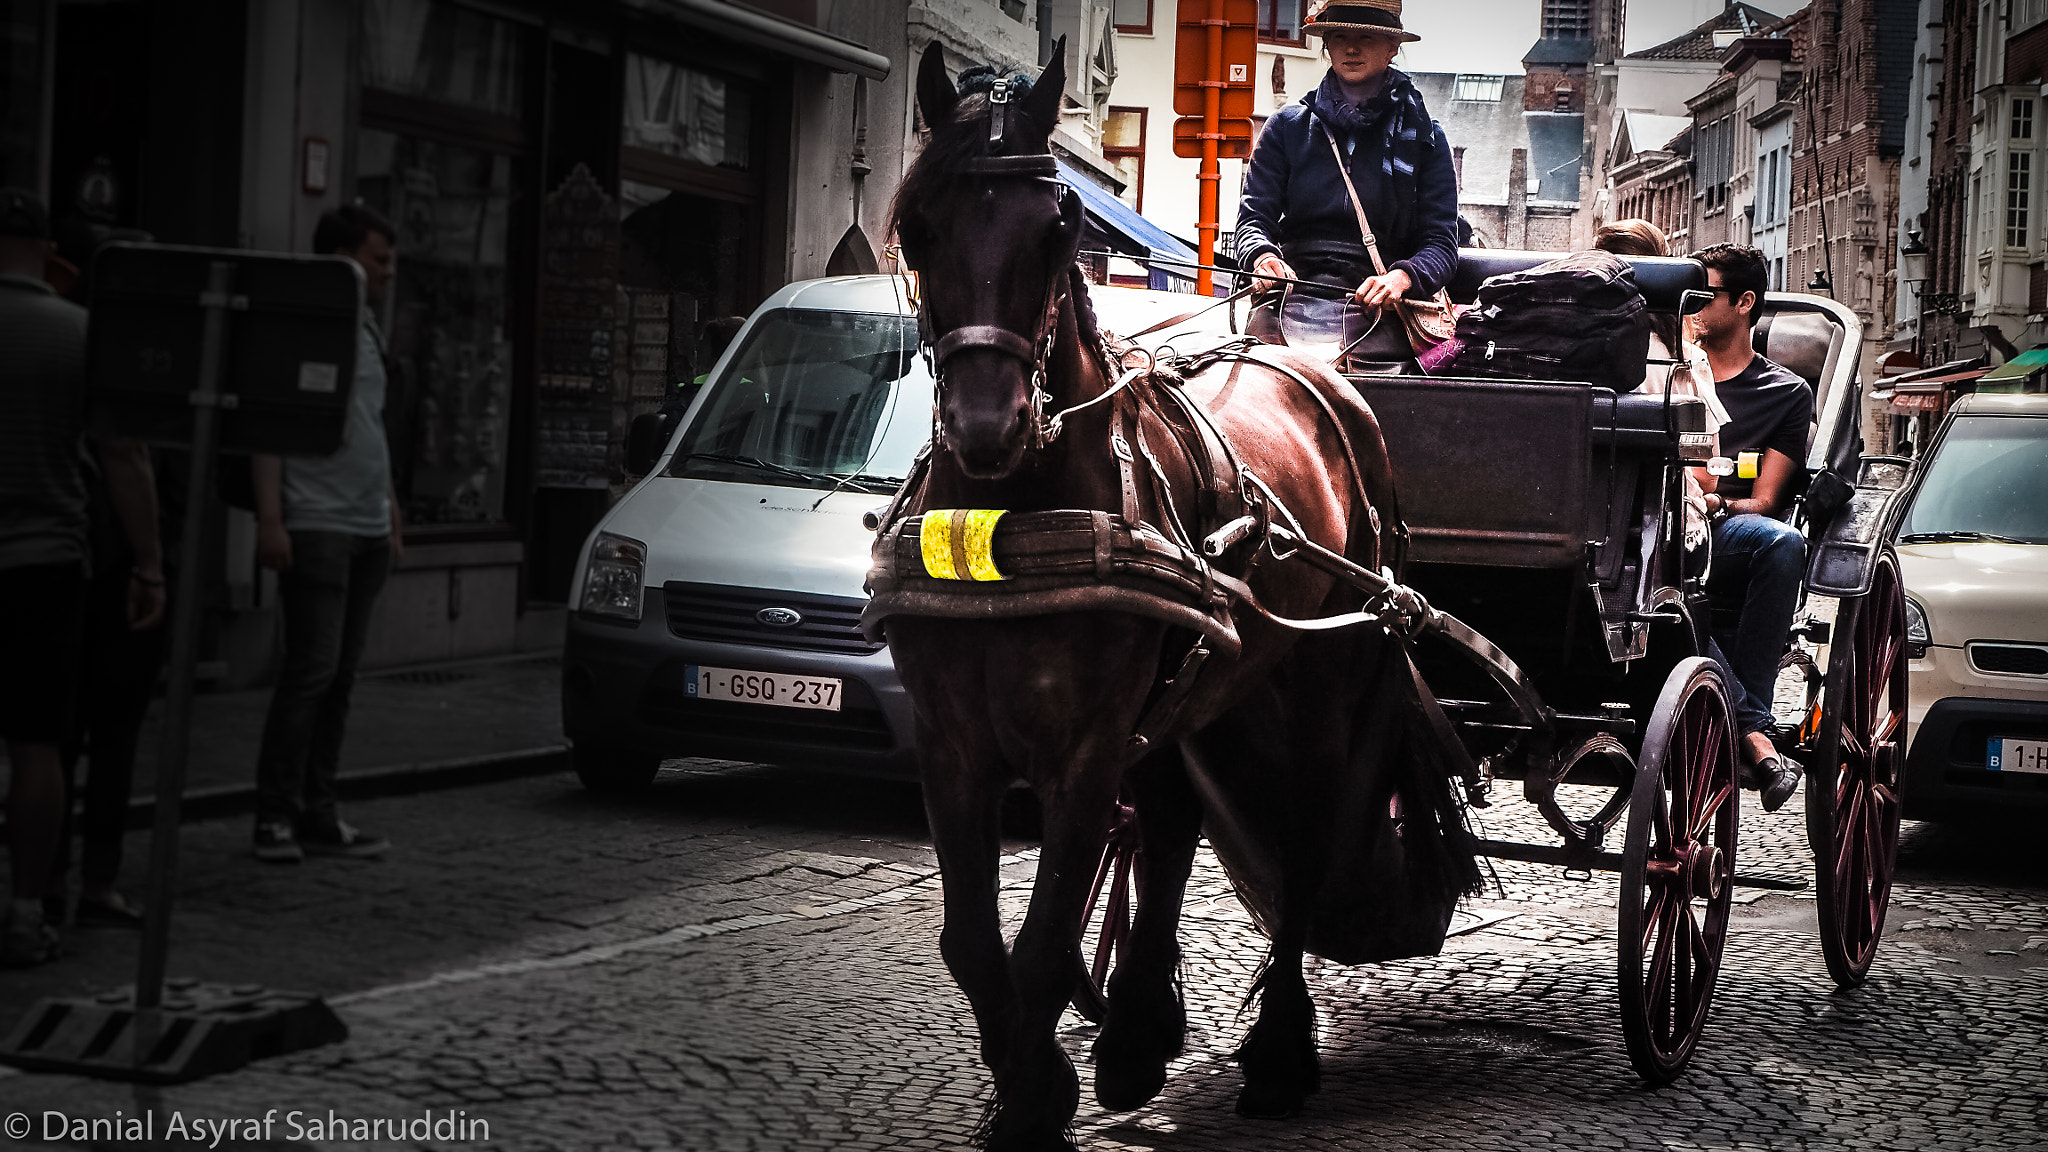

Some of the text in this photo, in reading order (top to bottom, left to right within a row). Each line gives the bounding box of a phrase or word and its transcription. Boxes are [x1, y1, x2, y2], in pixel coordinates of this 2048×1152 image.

[765, 610, 790, 623] Ford
[687, 671, 837, 706] B 1-GSQ-237
[1990, 755, 2000, 767] B
